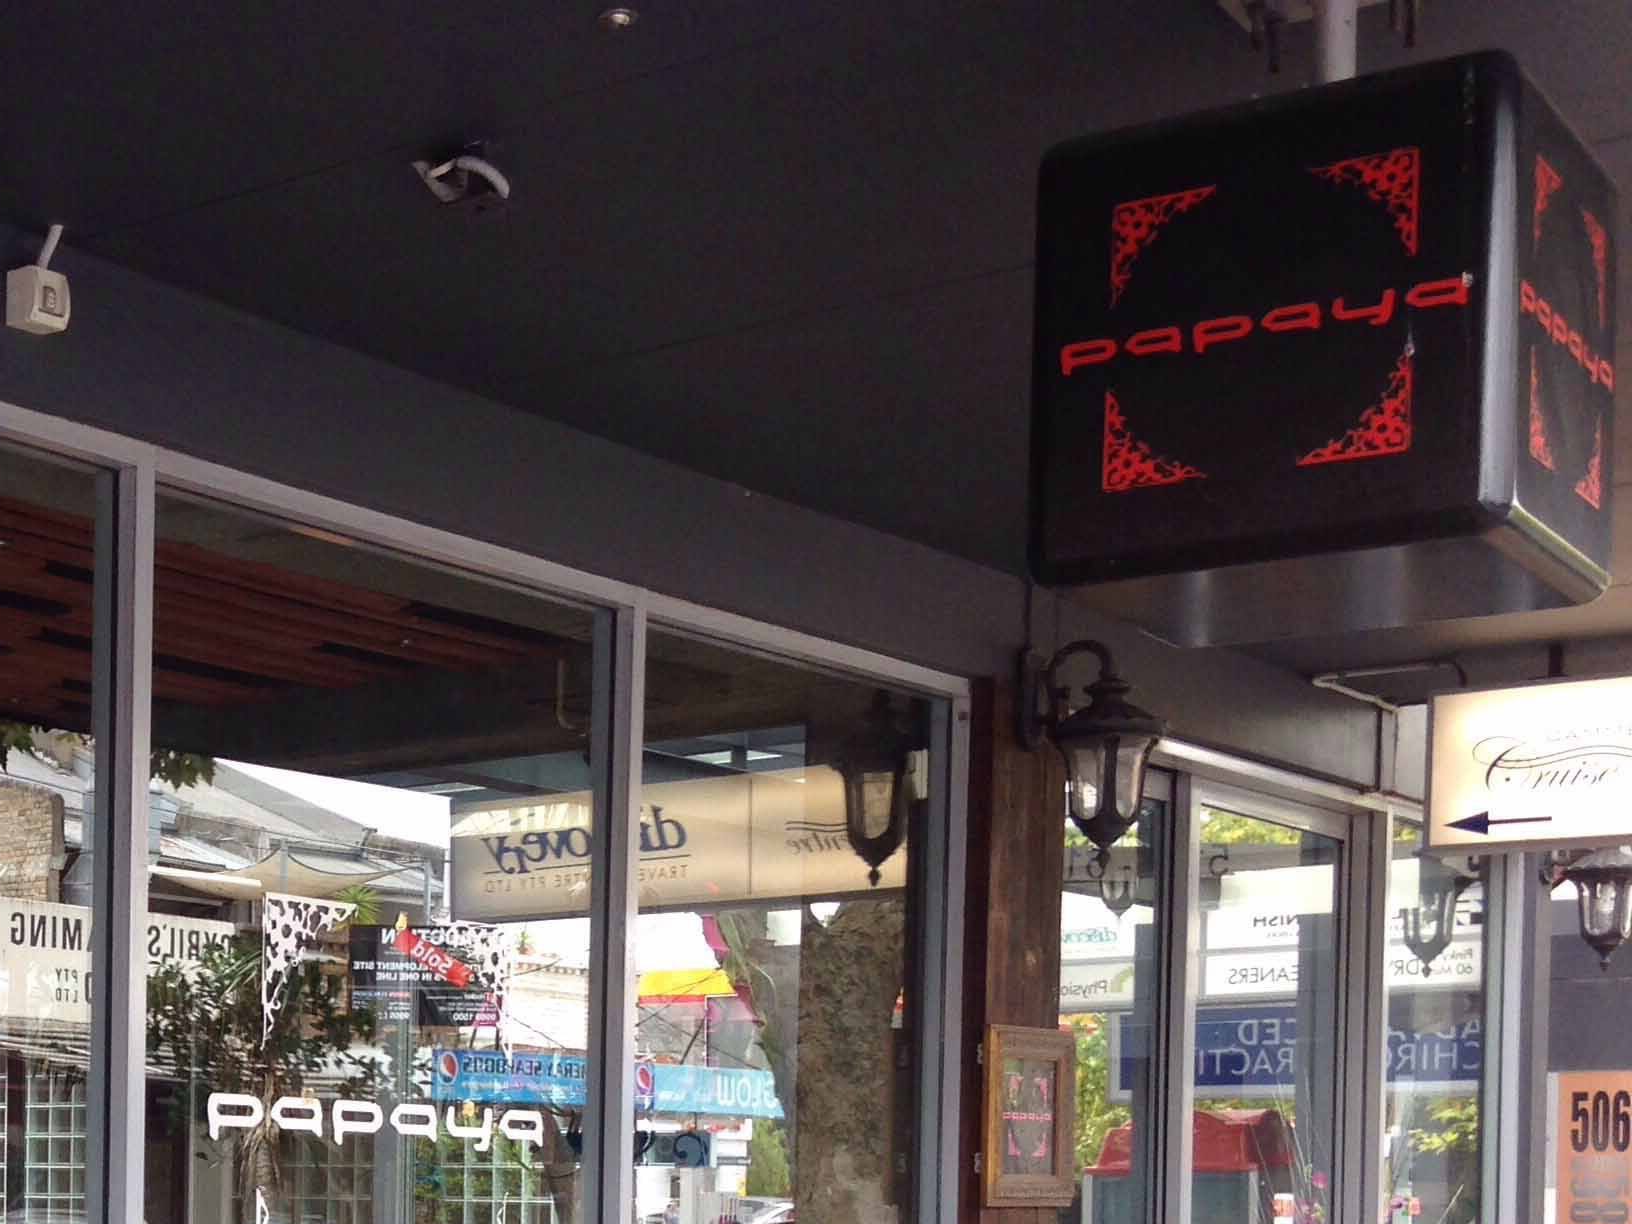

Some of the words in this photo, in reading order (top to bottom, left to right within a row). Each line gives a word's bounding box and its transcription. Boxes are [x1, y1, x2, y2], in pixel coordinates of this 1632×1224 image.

[1060, 274, 1470, 376] papaya
[1519, 279, 1615, 393] papaya
[206, 1091, 544, 1152] papaya
[1570, 1089, 1632, 1153] 506
